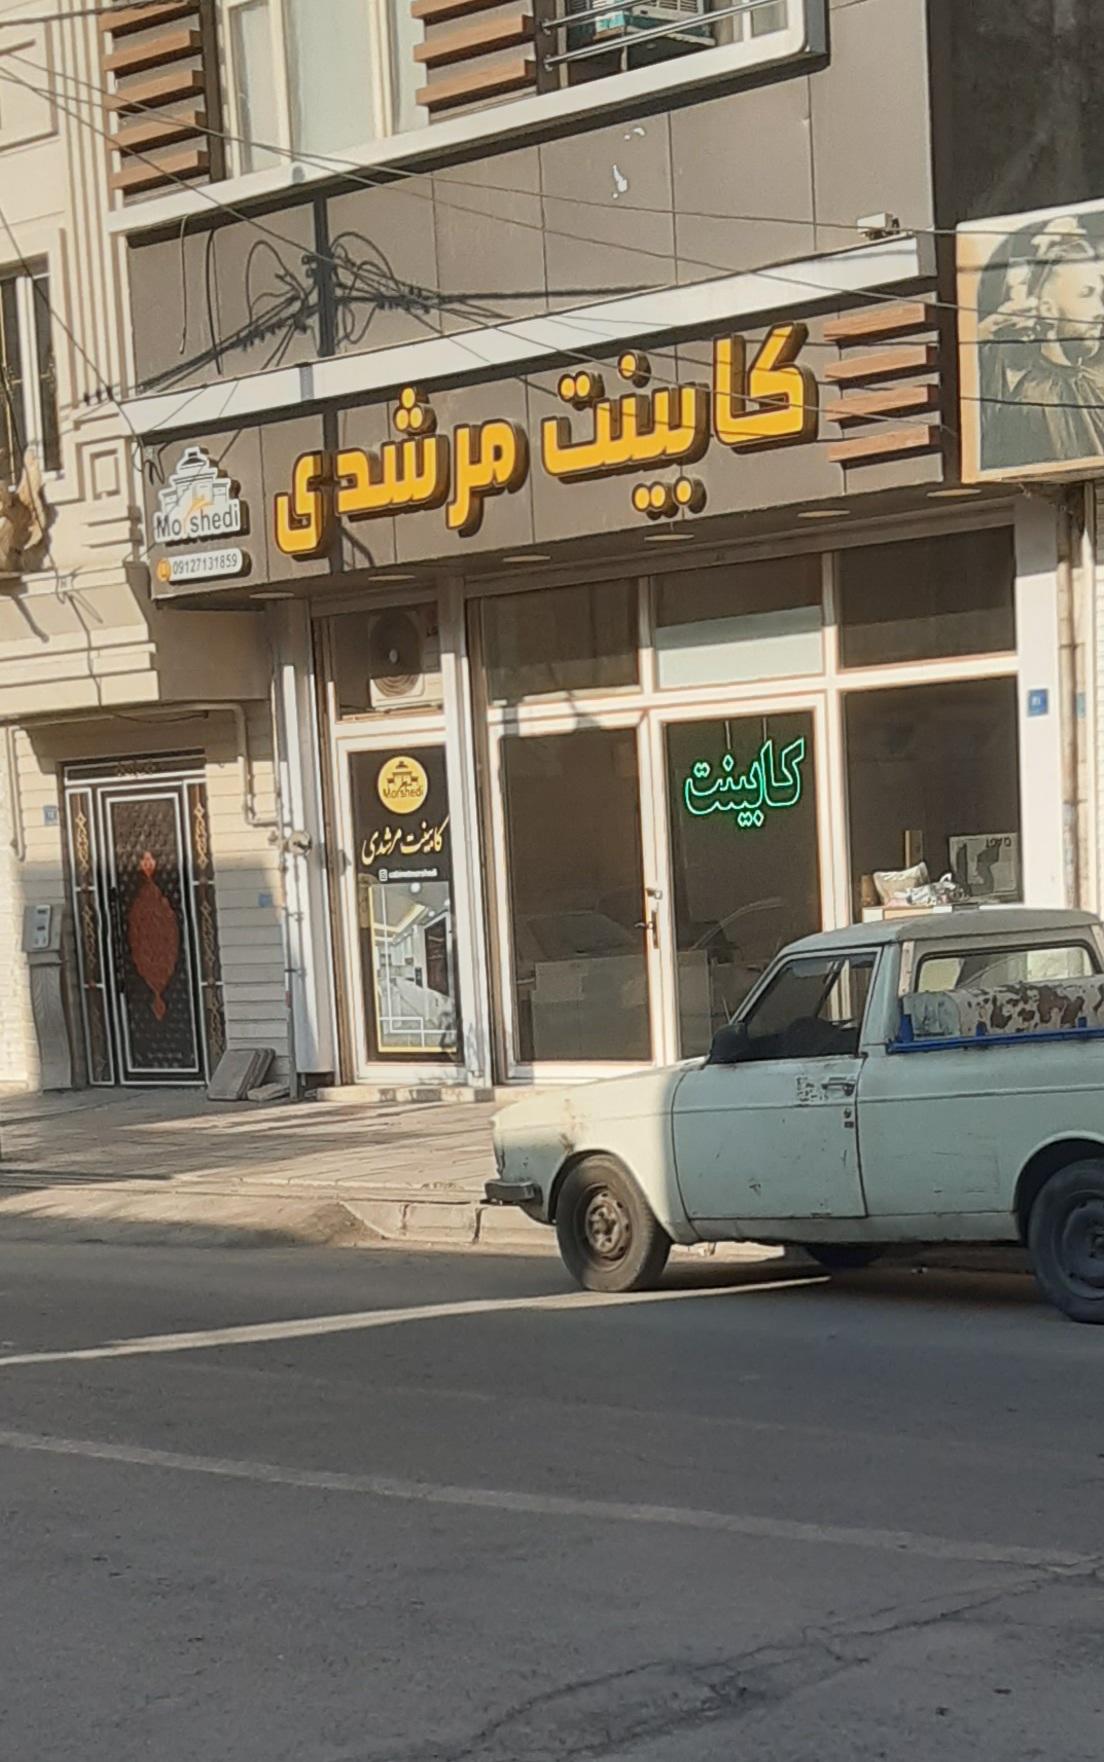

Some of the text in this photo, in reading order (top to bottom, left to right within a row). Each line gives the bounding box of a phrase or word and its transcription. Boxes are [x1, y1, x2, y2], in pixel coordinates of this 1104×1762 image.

[274, 322, 809, 557] کابینت مرشدی
[684, 737, 805, 828] کابینت
[361, 815, 450, 866] کابینت مرشدی
